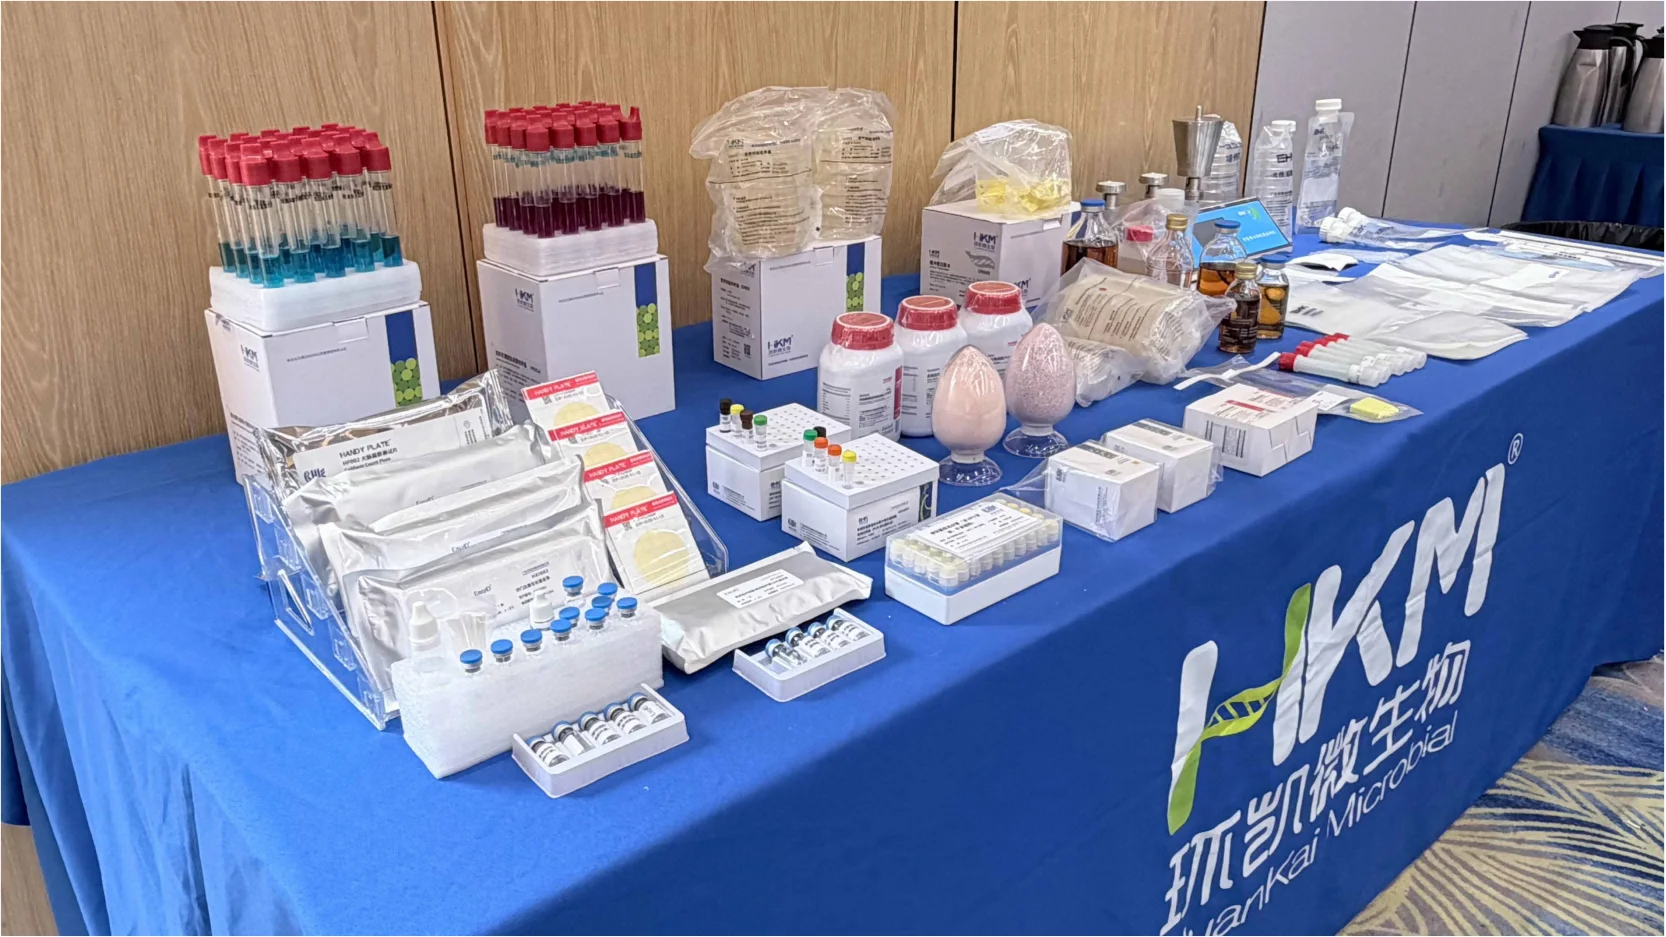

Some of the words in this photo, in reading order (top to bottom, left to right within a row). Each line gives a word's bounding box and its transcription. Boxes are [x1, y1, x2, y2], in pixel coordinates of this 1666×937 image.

[973, 231, 996, 245] HKM
[767, 336, 792, 351] HKM
[339, 446, 365, 459] HANDY
[366, 440, 391, 451] PLATE
[608, 462, 627, 472] PLATE
[609, 512, 630, 523] HANDY
[630, 504, 649, 515] PLATE
[1167, 462, 1506, 836] HKM
[1158, 639, 1473, 937] 环凯微生物
[1183, 828, 1321, 937] uanKai
[1326, 710, 1459, 840] Microbial
